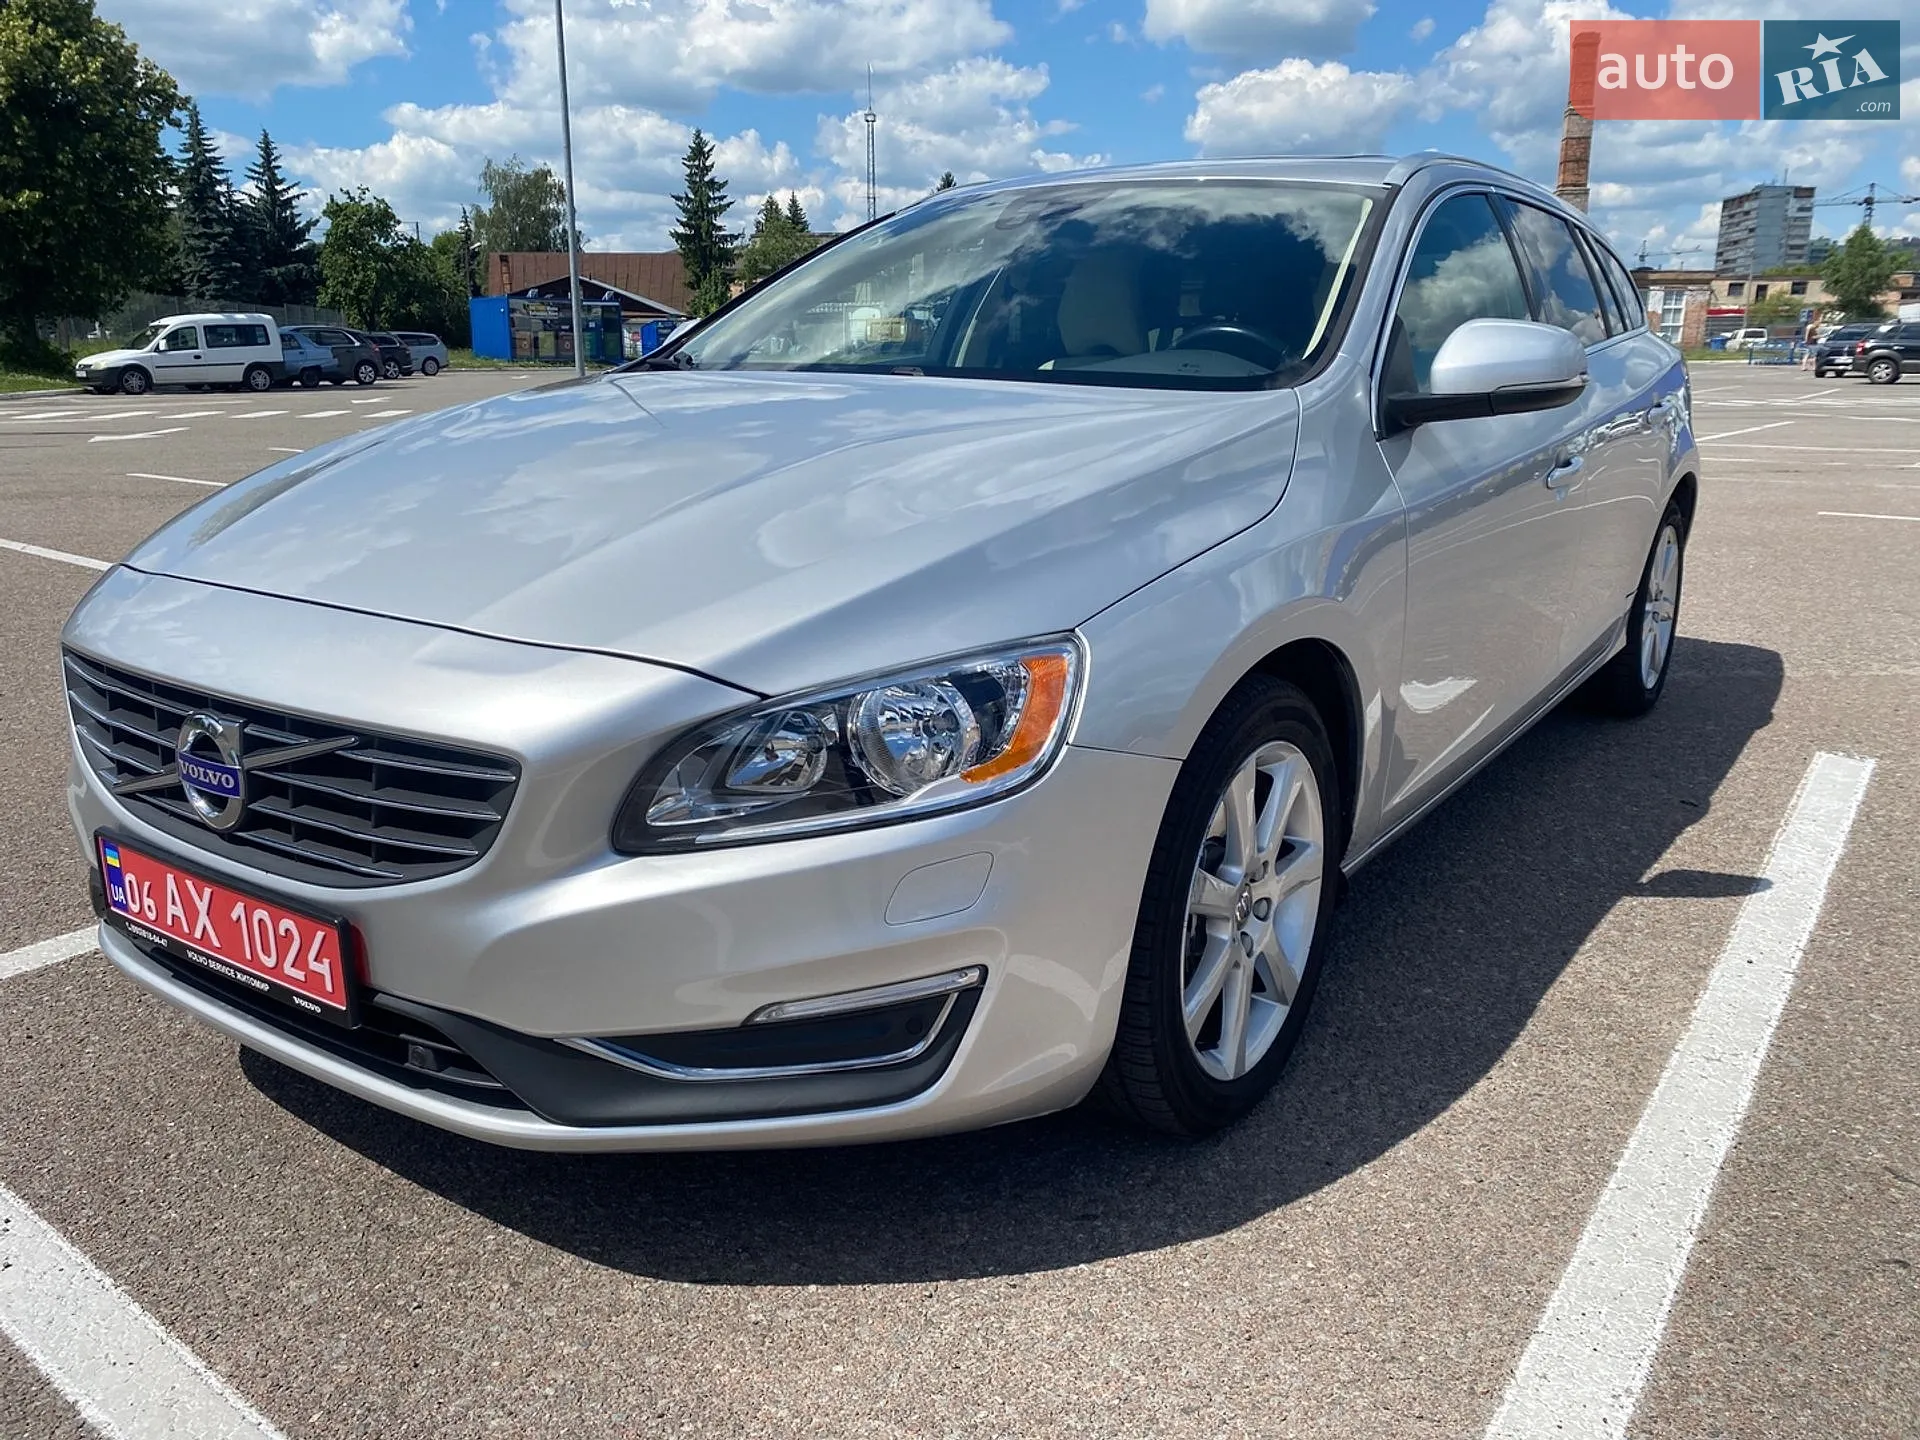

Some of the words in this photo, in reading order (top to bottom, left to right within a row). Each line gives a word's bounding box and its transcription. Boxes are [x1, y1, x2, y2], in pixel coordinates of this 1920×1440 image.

[179, 760, 235, 789] VOLVO
[111, 883, 127, 904] UA
[125, 872, 158, 921] 06
[166, 873, 221, 948] AX
[231, 901, 333, 993] 1024
[292, 995, 322, 1014] VOLVO
